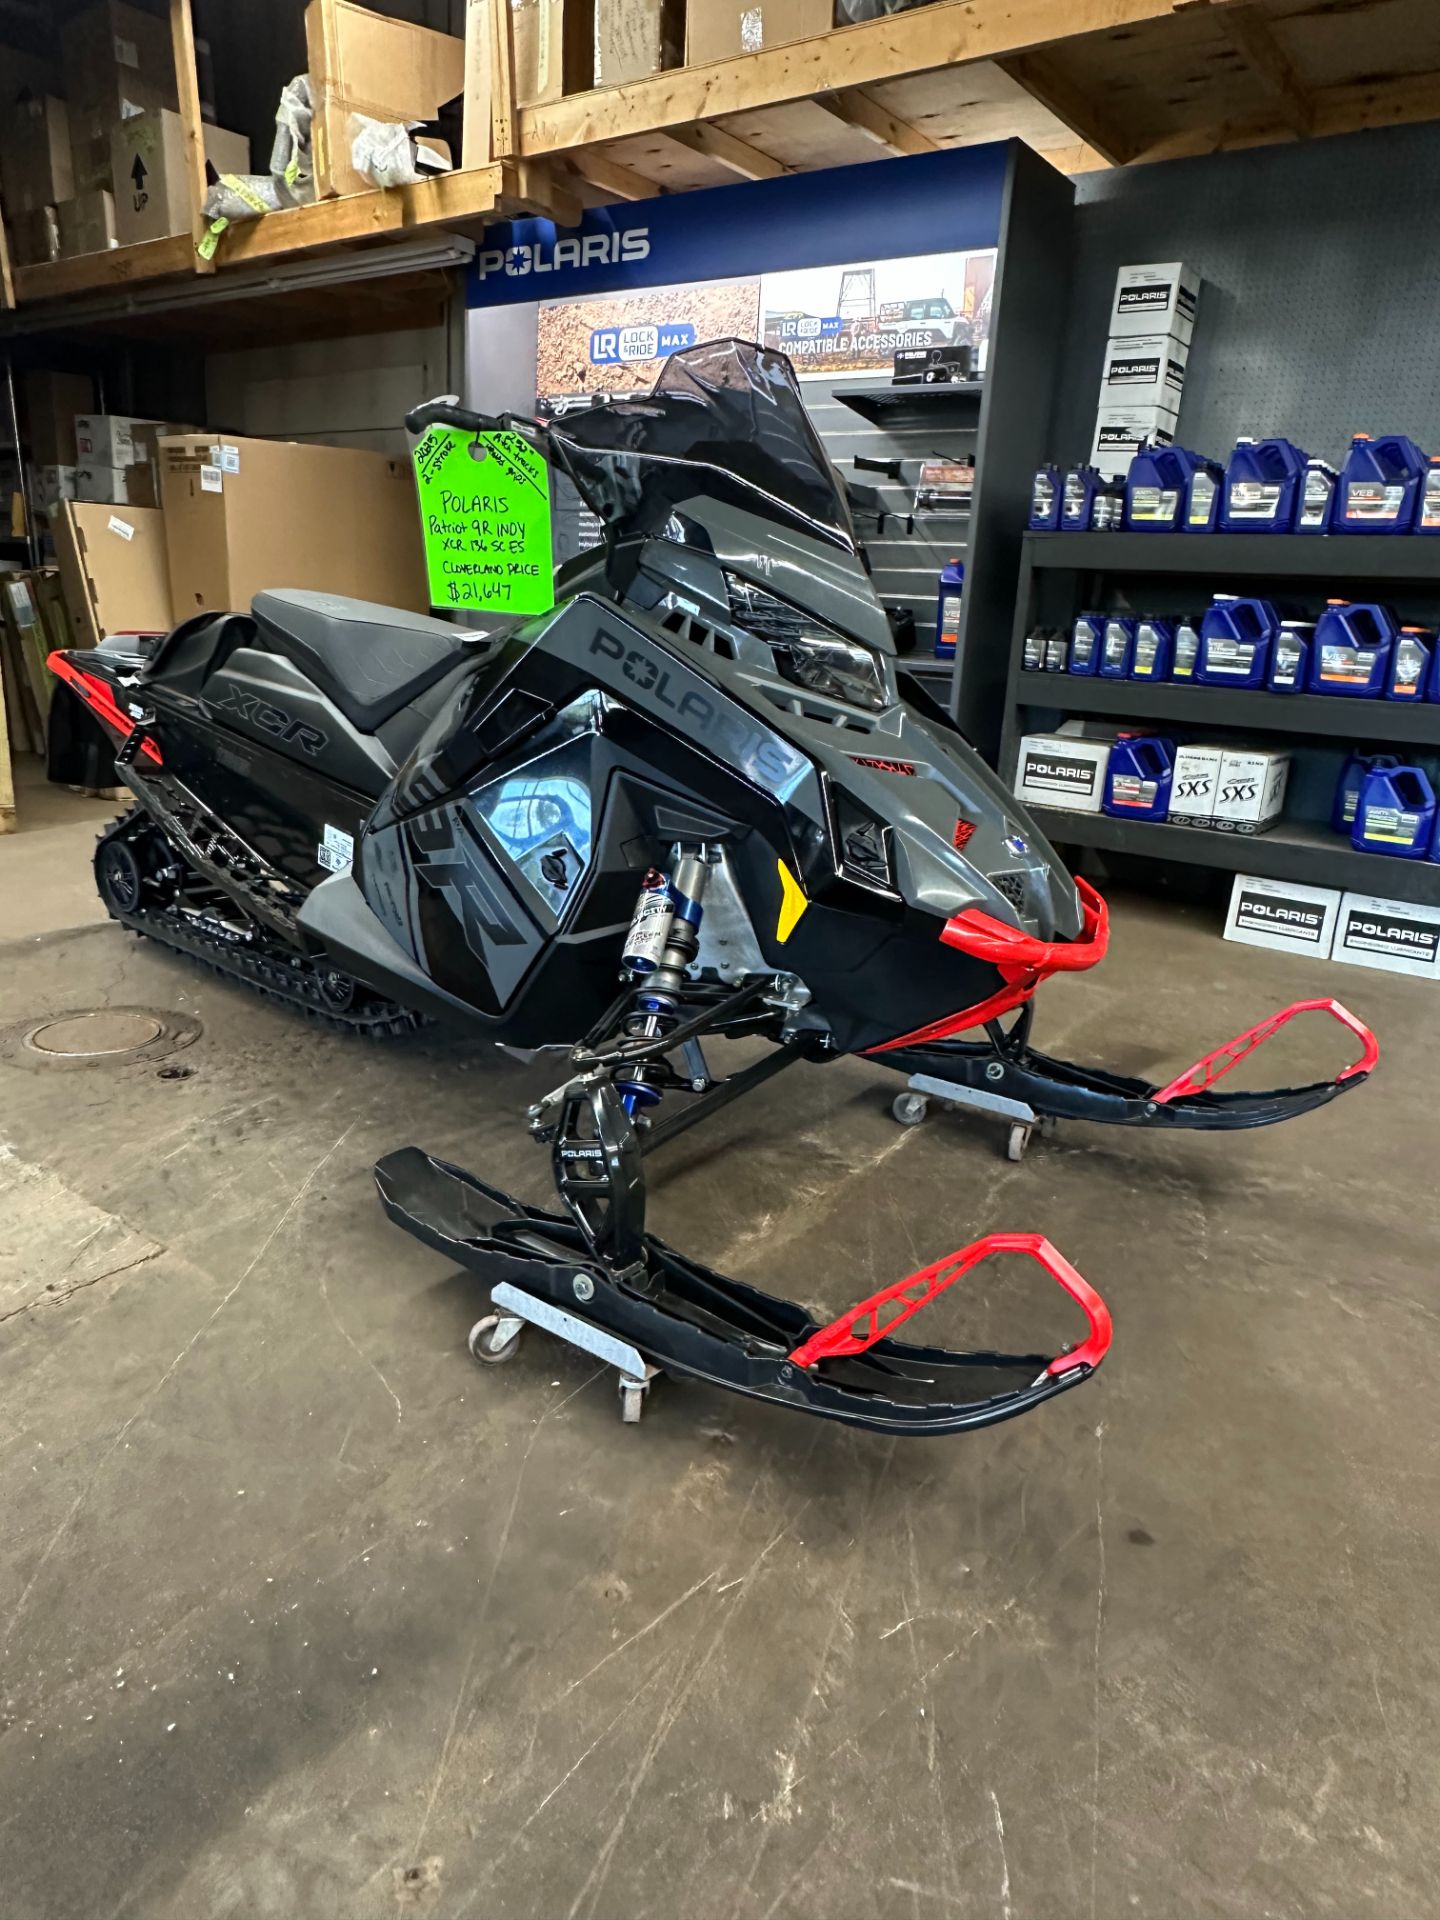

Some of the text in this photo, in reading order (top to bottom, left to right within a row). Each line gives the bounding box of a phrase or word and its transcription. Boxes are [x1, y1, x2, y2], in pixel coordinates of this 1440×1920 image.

[133, 194, 148, 212] UP
[479, 227, 650, 281] POLARIS
[1120, 291, 1169, 302] POLARIS
[623, 331, 654, 344] LOCK
[781, 321, 796, 336] LR
[593, 334, 616, 359] LR
[662, 334, 688, 347] MAX
[778, 331, 933, 355] COMPATIBLE ACCESSORIES
[1111, 364, 1157, 375] POLARIS
[414, 433, 438, 465] 2025
[440, 490, 509, 514] POLARIS
[429, 515, 526, 540] Patriot 9R INDY
[442, 538, 467, 551] XCR
[491, 540, 505, 552] SC
[509, 540, 525, 554] ES
[507, 563, 540, 576] PRICE
[448, 581, 511, 602] $21,647
[588, 627, 795, 784] POLARIS
[216, 684, 329, 757] XCR
[1026, 762, 1092, 779] POLARIS
[1240, 901, 1318, 925] POLARIS
[1349, 921, 1434, 945] POLARIS
[561, 1149, 602, 1157] POLARIS
